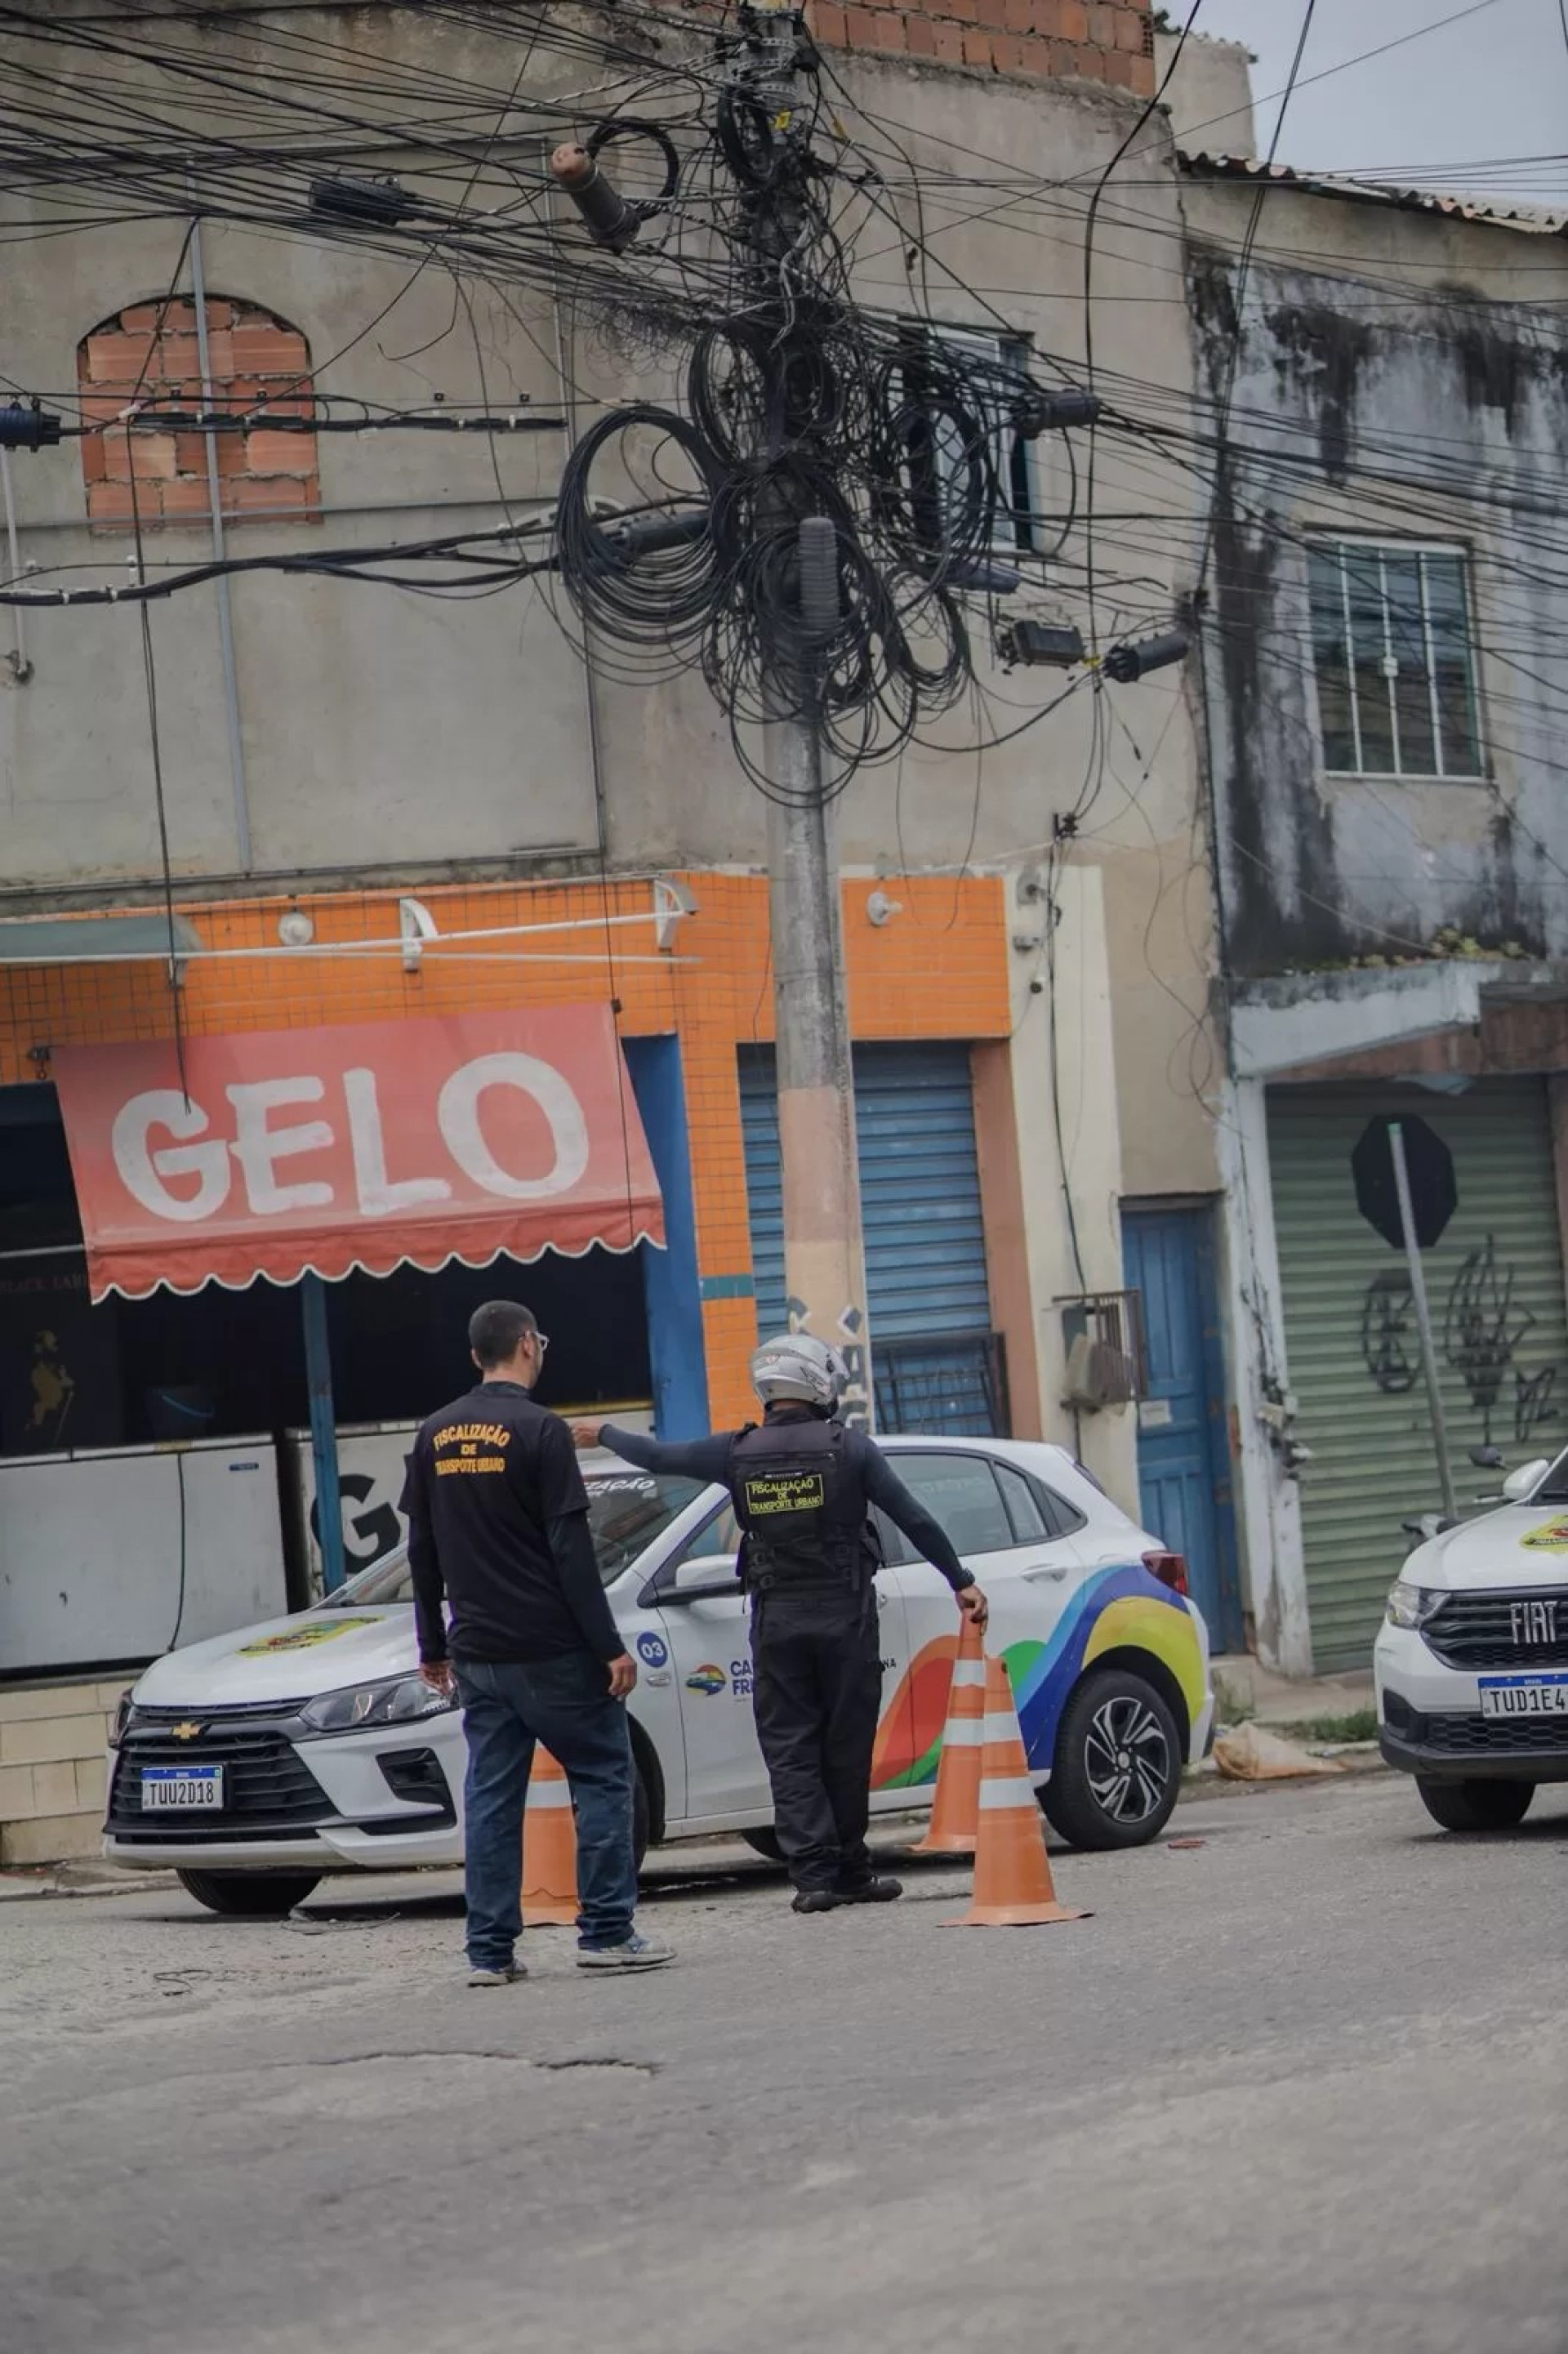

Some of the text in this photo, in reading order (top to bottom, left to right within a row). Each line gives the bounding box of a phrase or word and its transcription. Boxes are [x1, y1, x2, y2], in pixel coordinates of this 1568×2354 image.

[112, 1051, 589, 1221] GELO
[434, 1424, 511, 1451] FISCALIZAÇÃO
[461, 1443, 477, 1455] DE
[1511, 1601, 1557, 1644] FIAT
[642, 1643, 664, 1659] 03
[731, 1659, 753, 1677] CA
[733, 1679, 753, 1695] FR
[1490, 1688, 1567, 1713] TUD1E4
[149, 1781, 214, 1805] TUU2D18
